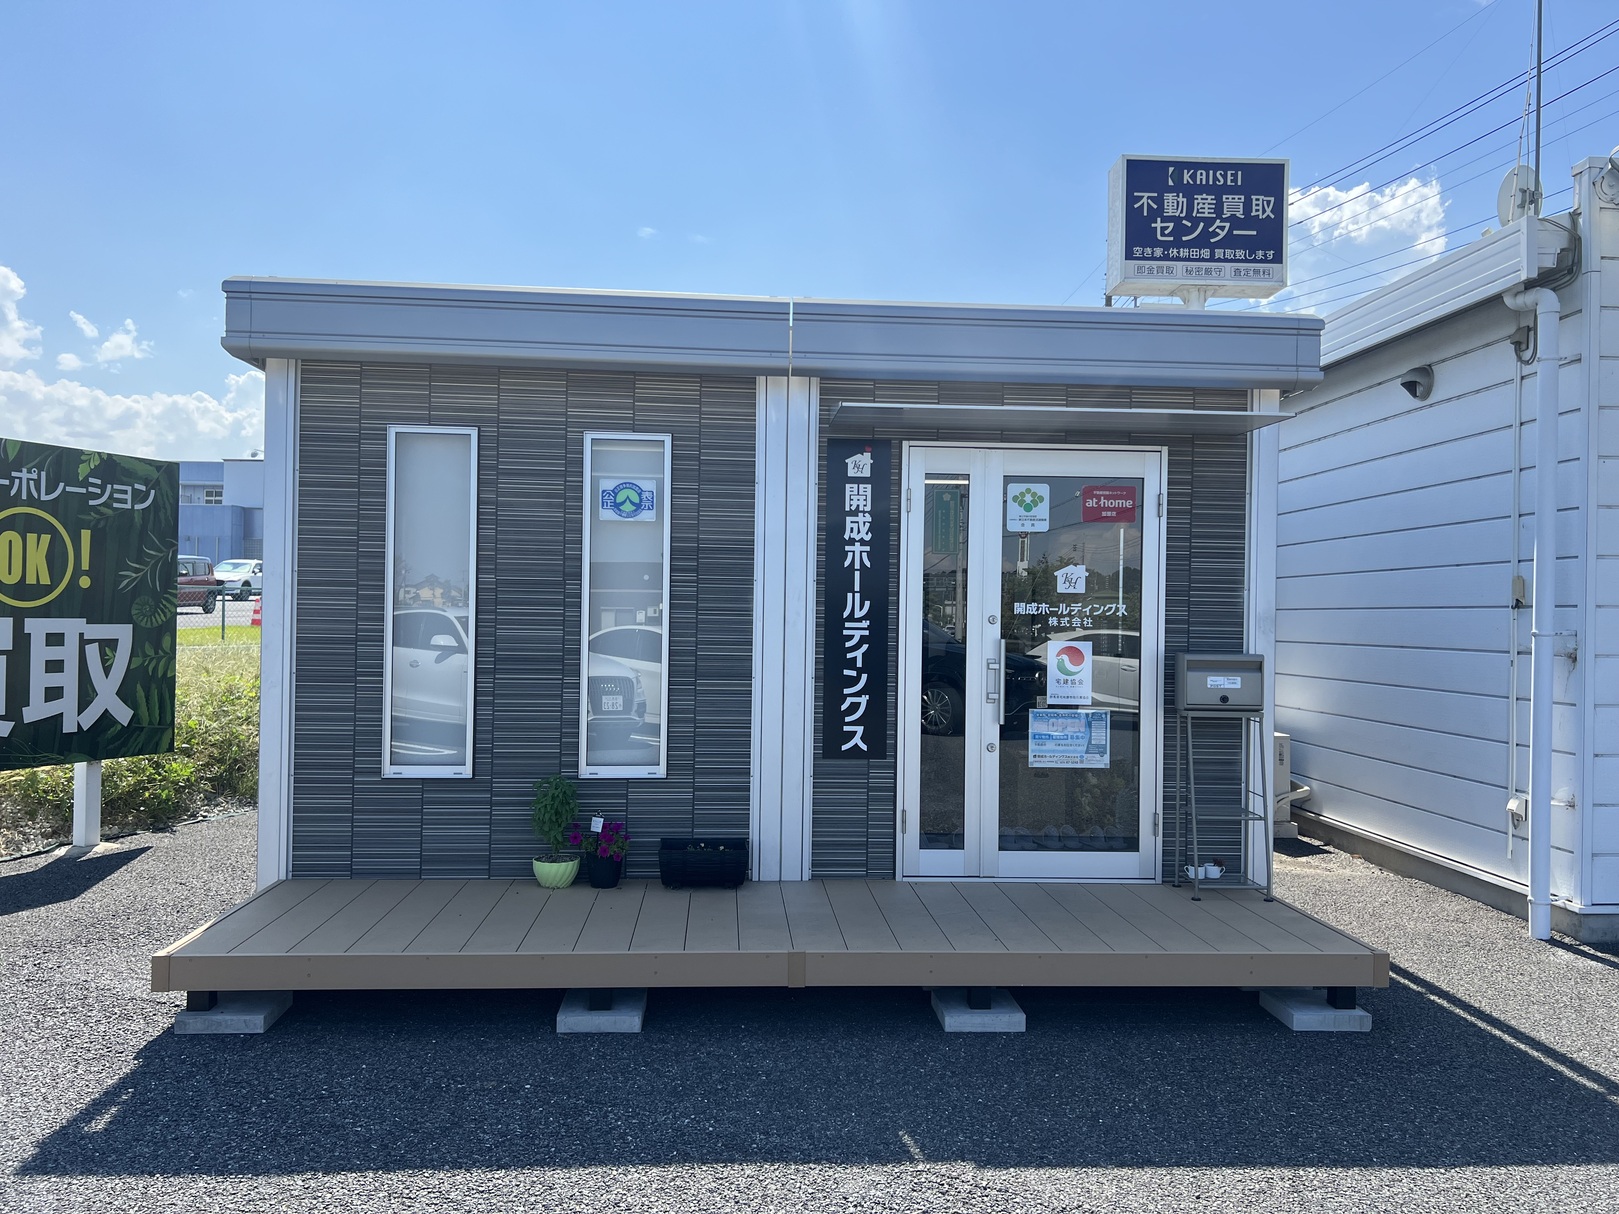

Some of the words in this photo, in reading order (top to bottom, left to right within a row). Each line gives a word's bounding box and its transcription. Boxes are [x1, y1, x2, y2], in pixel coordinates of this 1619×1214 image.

[1183, 169, 1242, 186] KAISEI
[1133, 192, 1275, 219] 不動産買取
[1151, 217, 1257, 243] センター
[1132, 246, 1211, 260] 空き家・休耕田畑
[1214, 248, 1275, 261] 買取致します
[1136, 265, 1175, 276] 即金買取
[1184, 266, 1223, 277] 秘密厳守
[1232, 268, 1271, 278] 査定無料
[1085, 497, 1098, 507] at
[1098, 496, 1133, 508] home
[1013, 602, 1128, 617] 開成ホールディングス
[841, 483, 873, 752] 開成ホールディングス
[1048, 616, 1093, 628] 株式会社
[0, 617, 134, 738] 取
